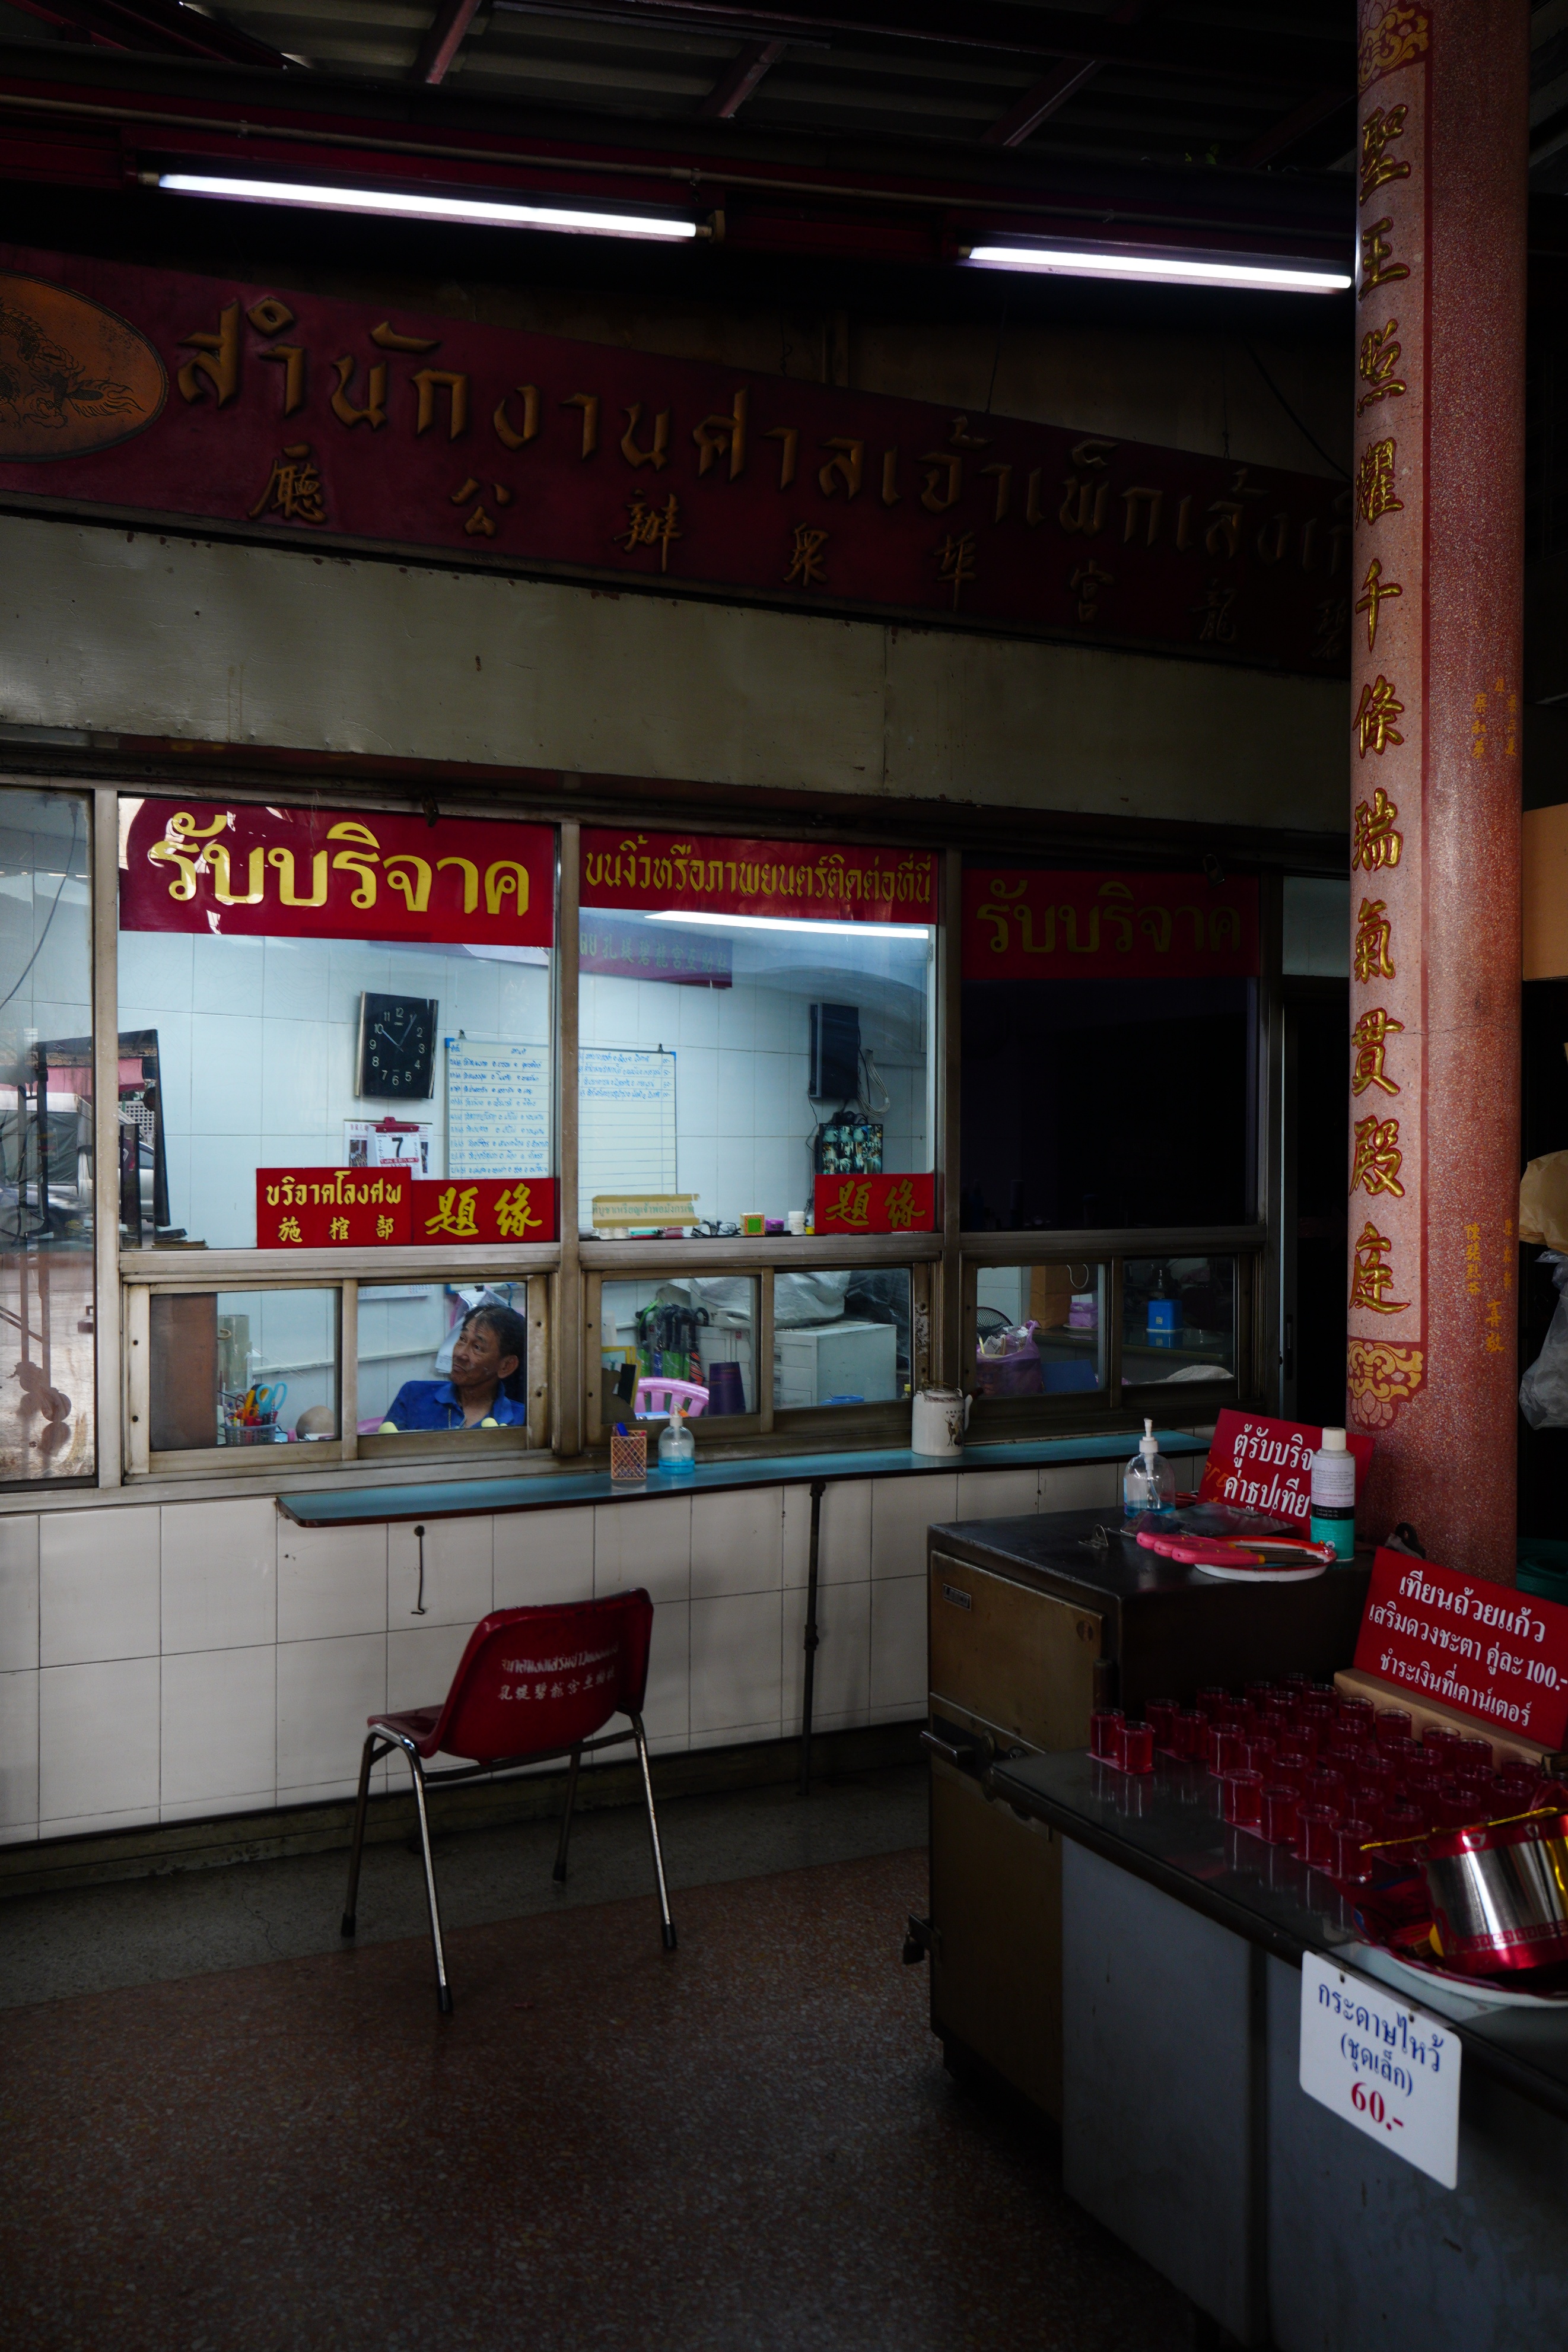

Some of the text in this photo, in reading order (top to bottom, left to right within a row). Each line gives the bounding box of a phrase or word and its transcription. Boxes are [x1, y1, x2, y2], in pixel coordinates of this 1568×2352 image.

[147, 811, 530, 917] รับบริจาค
[977, 878, 1241, 953] รับบริจาค
[374, 1023, 384, 1034] 10
[384, 1011, 390, 1022] 11
[396, 1007, 403, 1018] 12
[369, 1039, 377, 1050] 9
[416, 1027, 423, 1037] 2
[418, 1043, 425, 1054] 3
[372, 1056, 379, 1067] 8
[381, 1069, 387, 1080] 7
[405, 1071, 412, 1082] 5
[414, 1060, 421, 1070] 4
[392, 1075, 399, 1086] 6
[392, 1137, 403, 1158] 7
[265, 1170, 403, 1206] บริจาคโลงศพ
[825, 1178, 926, 1229] 題緣
[424, 1183, 543, 1237] 題緣
[1233, 1423, 1313, 1471] ตู้รับบริจ
[1224, 1469, 1311, 1518] ค่าธูปเทีย
[1399, 1570, 1546, 1642] เทียนถ้วยแก้ว
[1368, 1601, 1481, 1661] เสริมดวงชะตา
[1486, 1641, 1524, 1676] คู่ละ
[1380, 1648, 1532, 1727] ชำระเงินที่เคาน์เตอร์
[1319, 1983, 1444, 2072] กระดาษไหว้
[1341, 2033, 1413, 2097] (ชุดเล็ก)
[1351, 2082, 1404, 2131] 60.-
